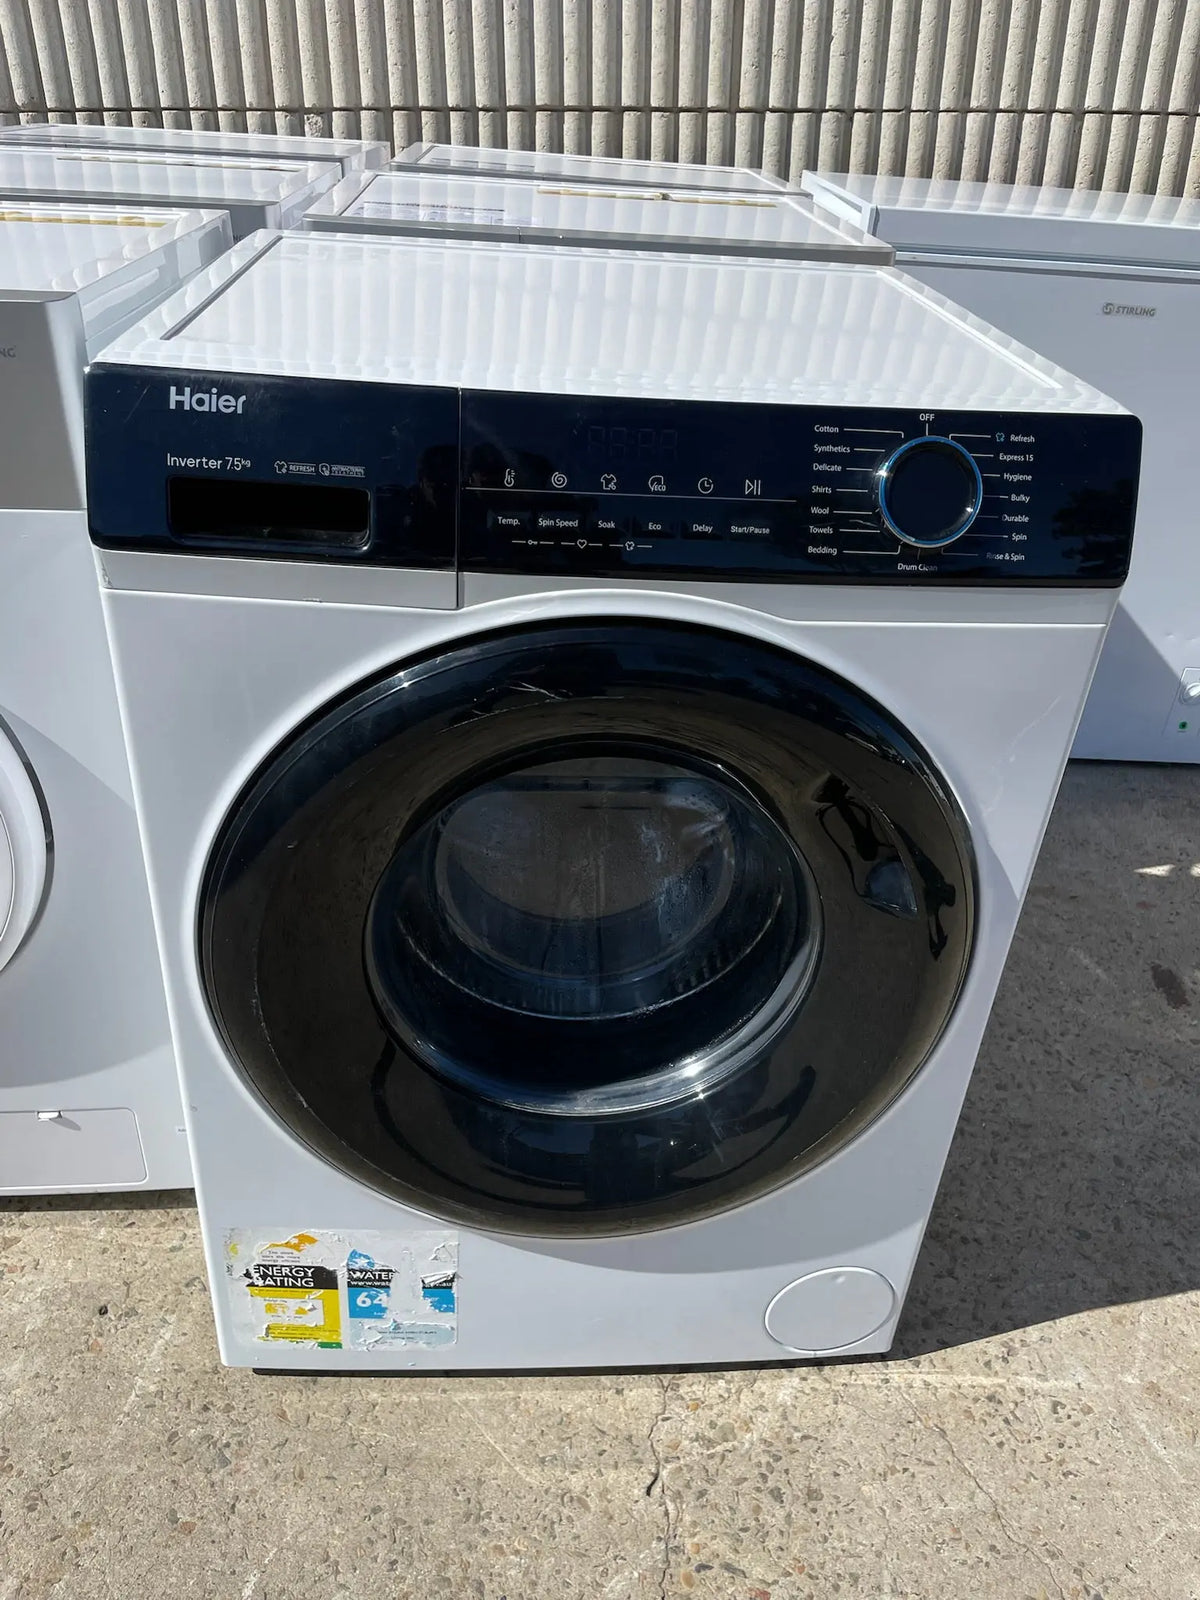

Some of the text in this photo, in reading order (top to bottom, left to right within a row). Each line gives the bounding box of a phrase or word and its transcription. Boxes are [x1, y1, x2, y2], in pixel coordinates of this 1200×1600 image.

[1115, 305, 1156, 317] STIRLING
[169, 386, 247, 414] Haier
[919, 413, 935, 422] OFF
[814, 424, 839, 433] Cotton
[1010, 434, 1035, 443] Refresh
[813, 444, 850, 454] Synthetics
[167, 452, 223, 469] Inverter
[999, 453, 1034, 463] Express 15
[289, 464, 315, 472] REFRESH
[813, 463, 842, 472] Delicate
[1003, 472, 1032, 482] Hygiene
[654, 484, 667, 492] ECO
[811, 485, 832, 494] Shirts
[1010, 493, 1030, 503] Bulky
[810, 506, 829, 515] Wool
[498, 517, 520, 526] Temp.
[538, 517, 578, 528] Spin Speed
[1002, 514, 1029, 523] Durable
[598, 520, 615, 529] Soak
[648, 522, 661, 531] Eco
[693, 523, 713, 533] Delay
[731, 525, 770, 535] Start/Pause
[809, 525, 833, 534] Towels
[1011, 532, 1027, 542] Spin
[808, 546, 837, 556] Bedding
[1010, 553, 1025, 562] Spin
[897, 563, 916, 571] Drum
